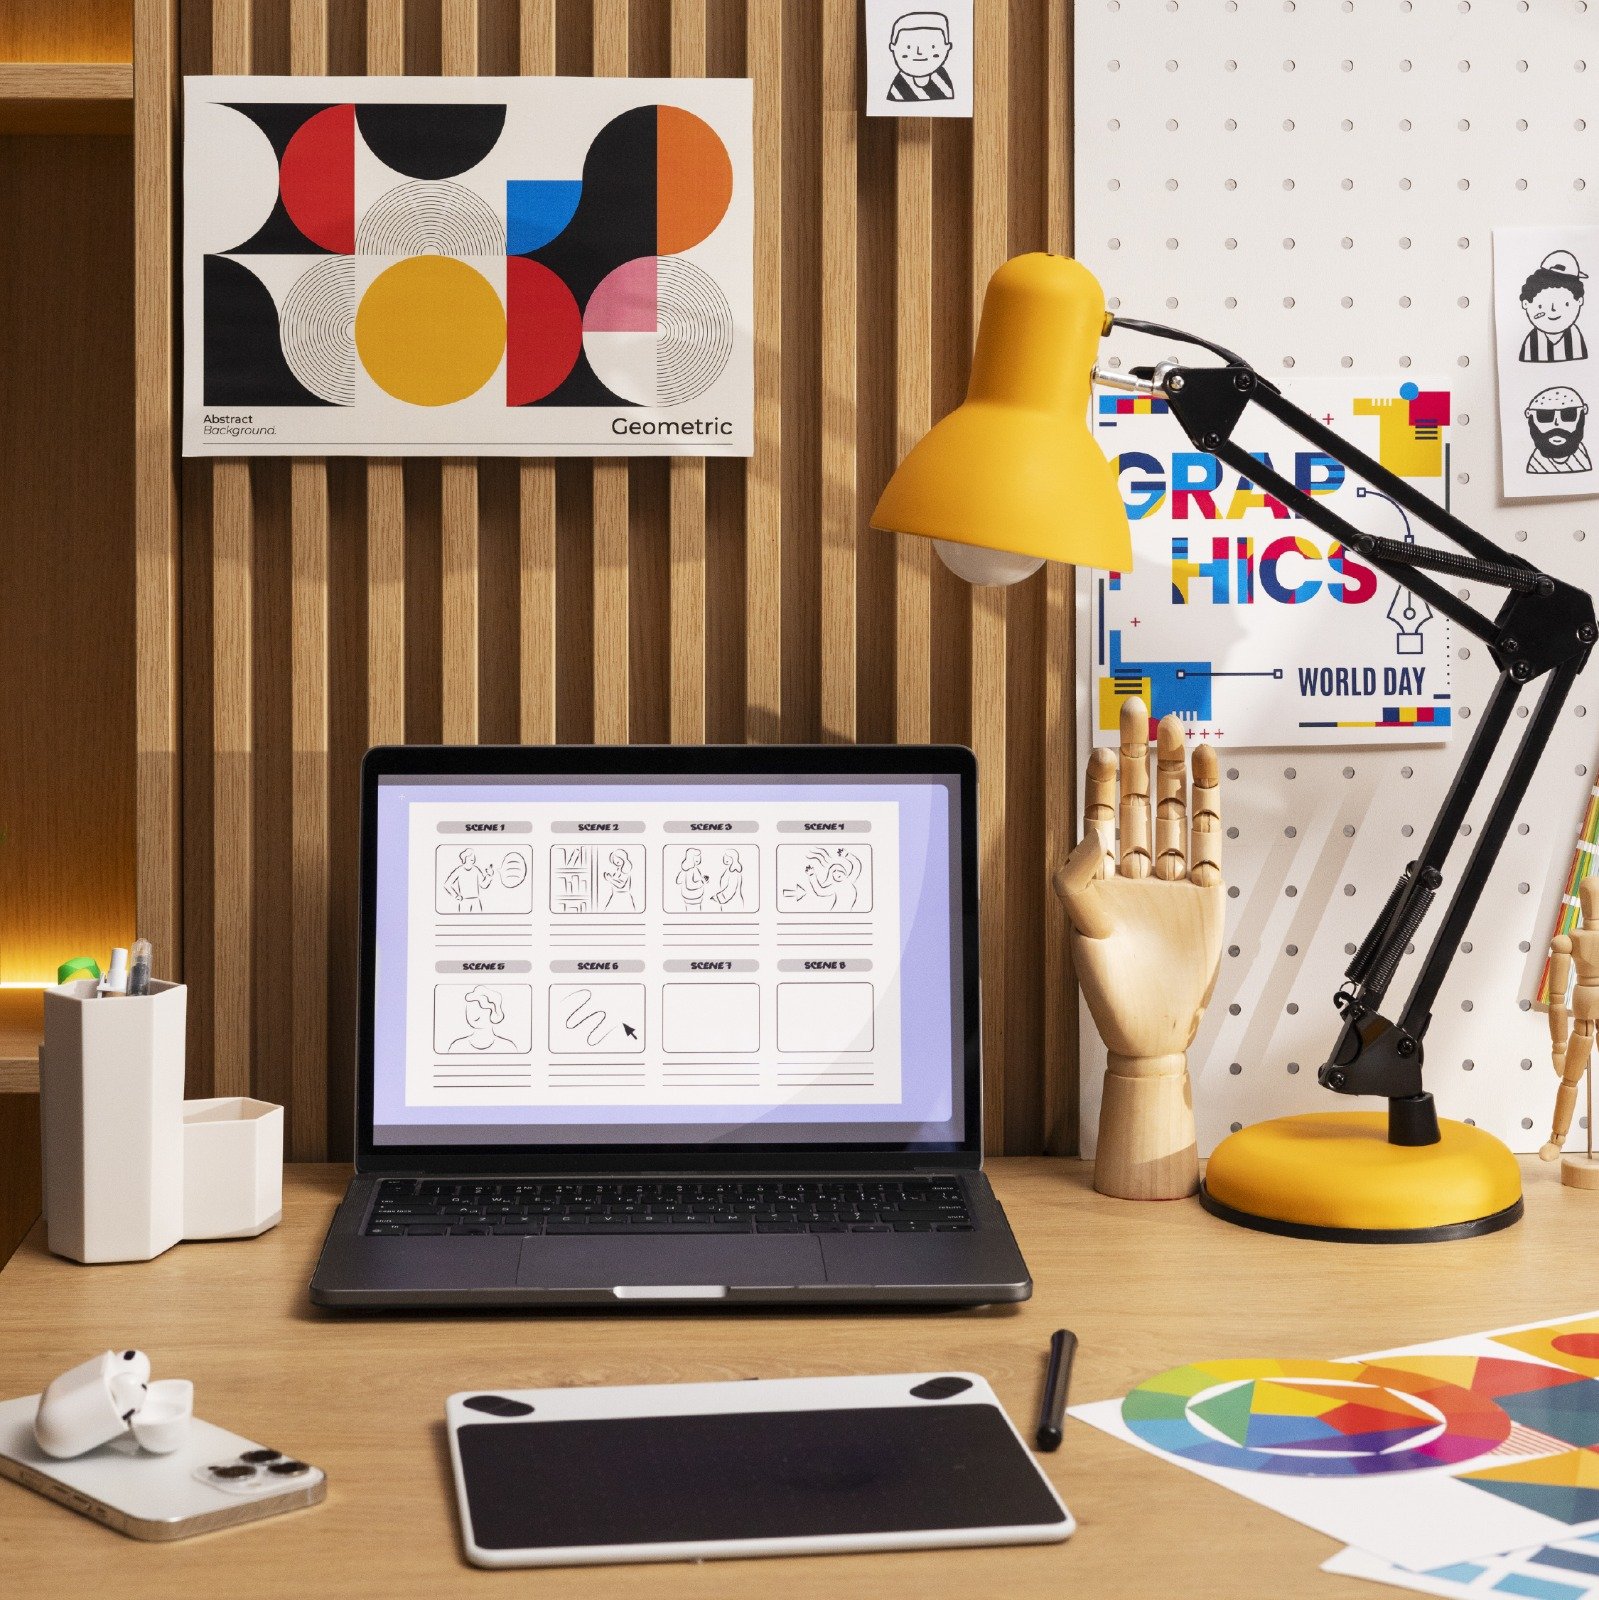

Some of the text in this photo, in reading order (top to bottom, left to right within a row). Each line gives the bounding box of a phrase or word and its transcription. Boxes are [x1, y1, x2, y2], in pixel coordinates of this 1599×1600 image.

[203, 413, 253, 424] Abstract
[611, 416, 733, 435] Geometric
[203, 424, 277, 438] Background.
[1172, 536, 1377, 604] HICS
[1297, 666, 1426, 697] WORLD DAY
[464, 823, 499, 832] SCENE
[577, 823, 612, 832] SCENE
[689, 823, 724, 831] SCENE
[803, 822, 838, 831] SCENE
[462, 962, 497, 971] SCENE
[577, 962, 611, 971] SCENE
[690, 961, 725, 970] SCENE
[803, 961, 838, 970] SCENE
